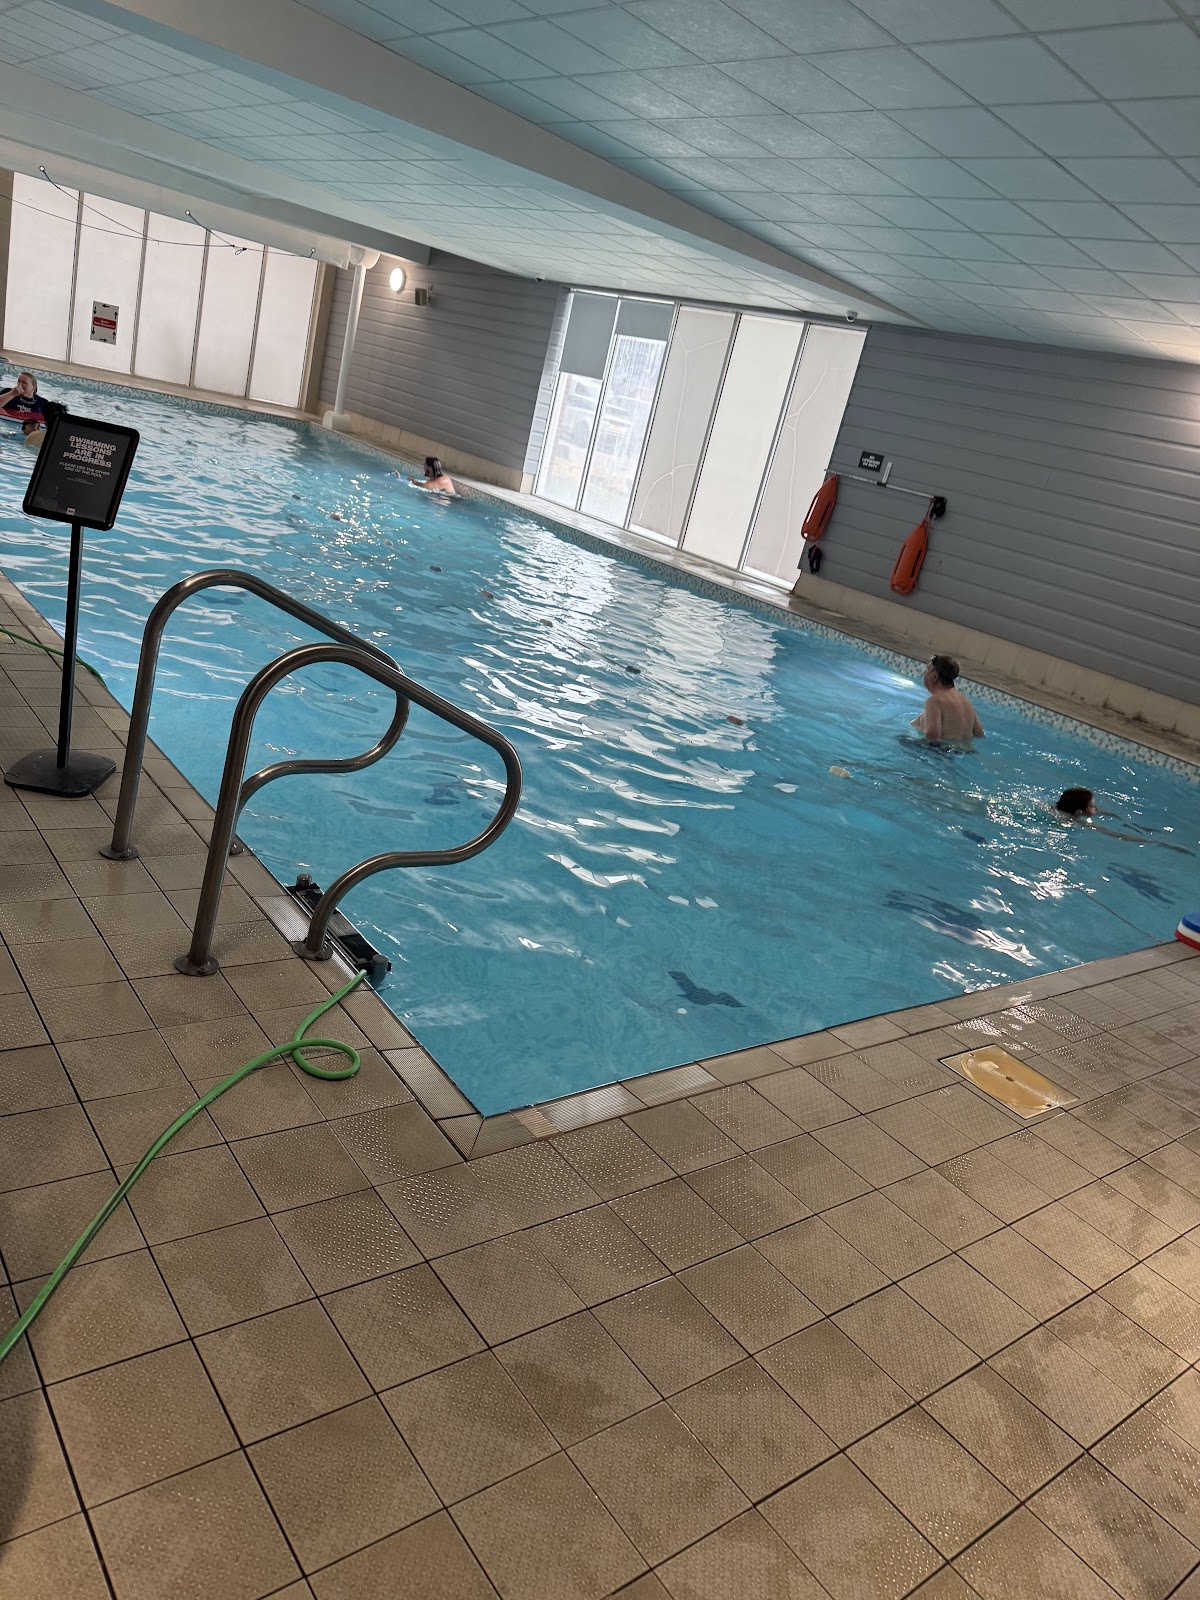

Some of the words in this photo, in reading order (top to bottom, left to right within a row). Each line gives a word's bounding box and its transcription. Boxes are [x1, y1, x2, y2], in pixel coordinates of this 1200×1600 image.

[69, 436, 116, 451] SWIMMING
[70, 441, 112, 456] LESSONS
[63, 451, 112, 468] PROGRESS
[74, 448, 93, 457] ARE
[95, 452, 105, 460] IN
